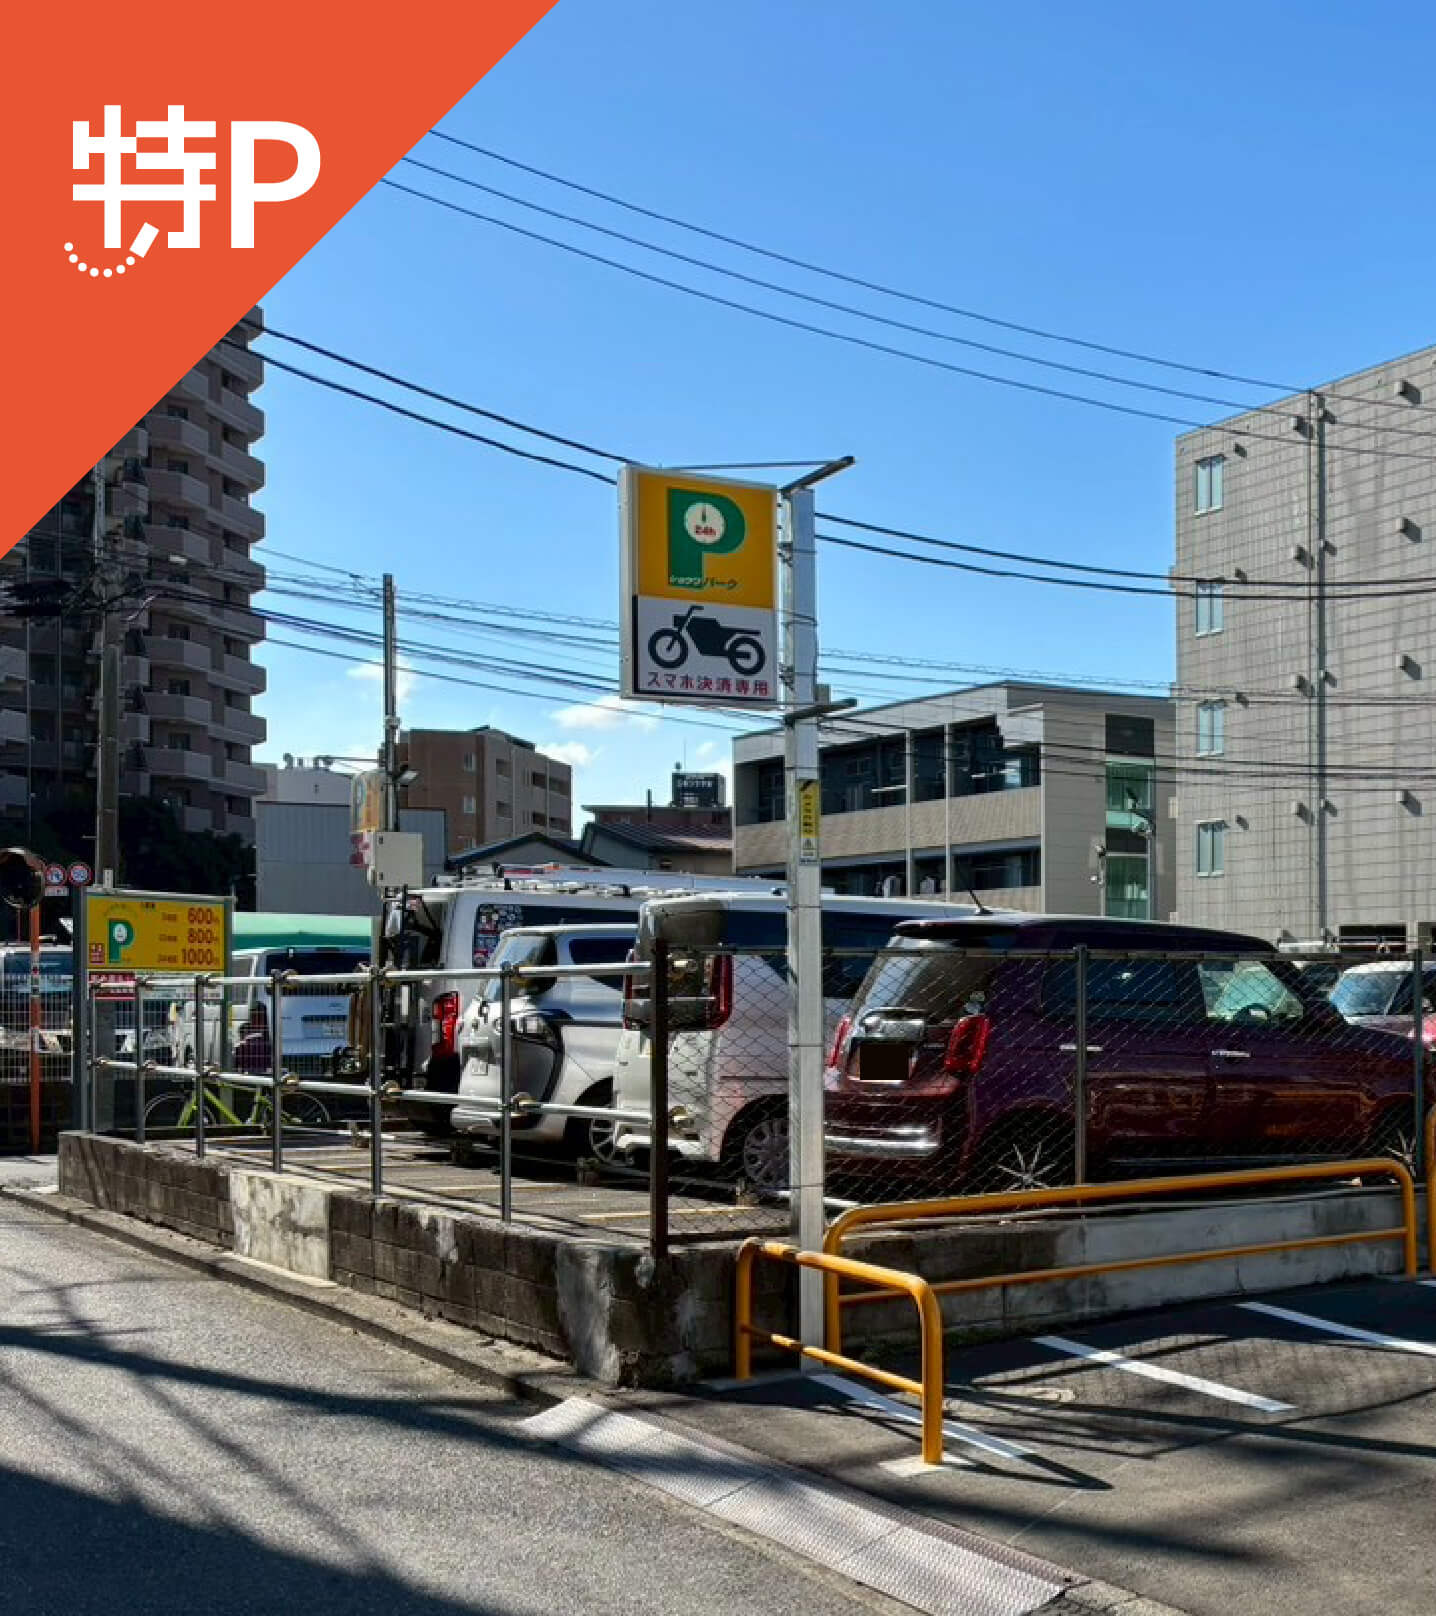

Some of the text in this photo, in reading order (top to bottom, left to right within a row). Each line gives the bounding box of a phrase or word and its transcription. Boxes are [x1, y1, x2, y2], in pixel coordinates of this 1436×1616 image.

[647, 671, 769, 696] スマホ決済専用
